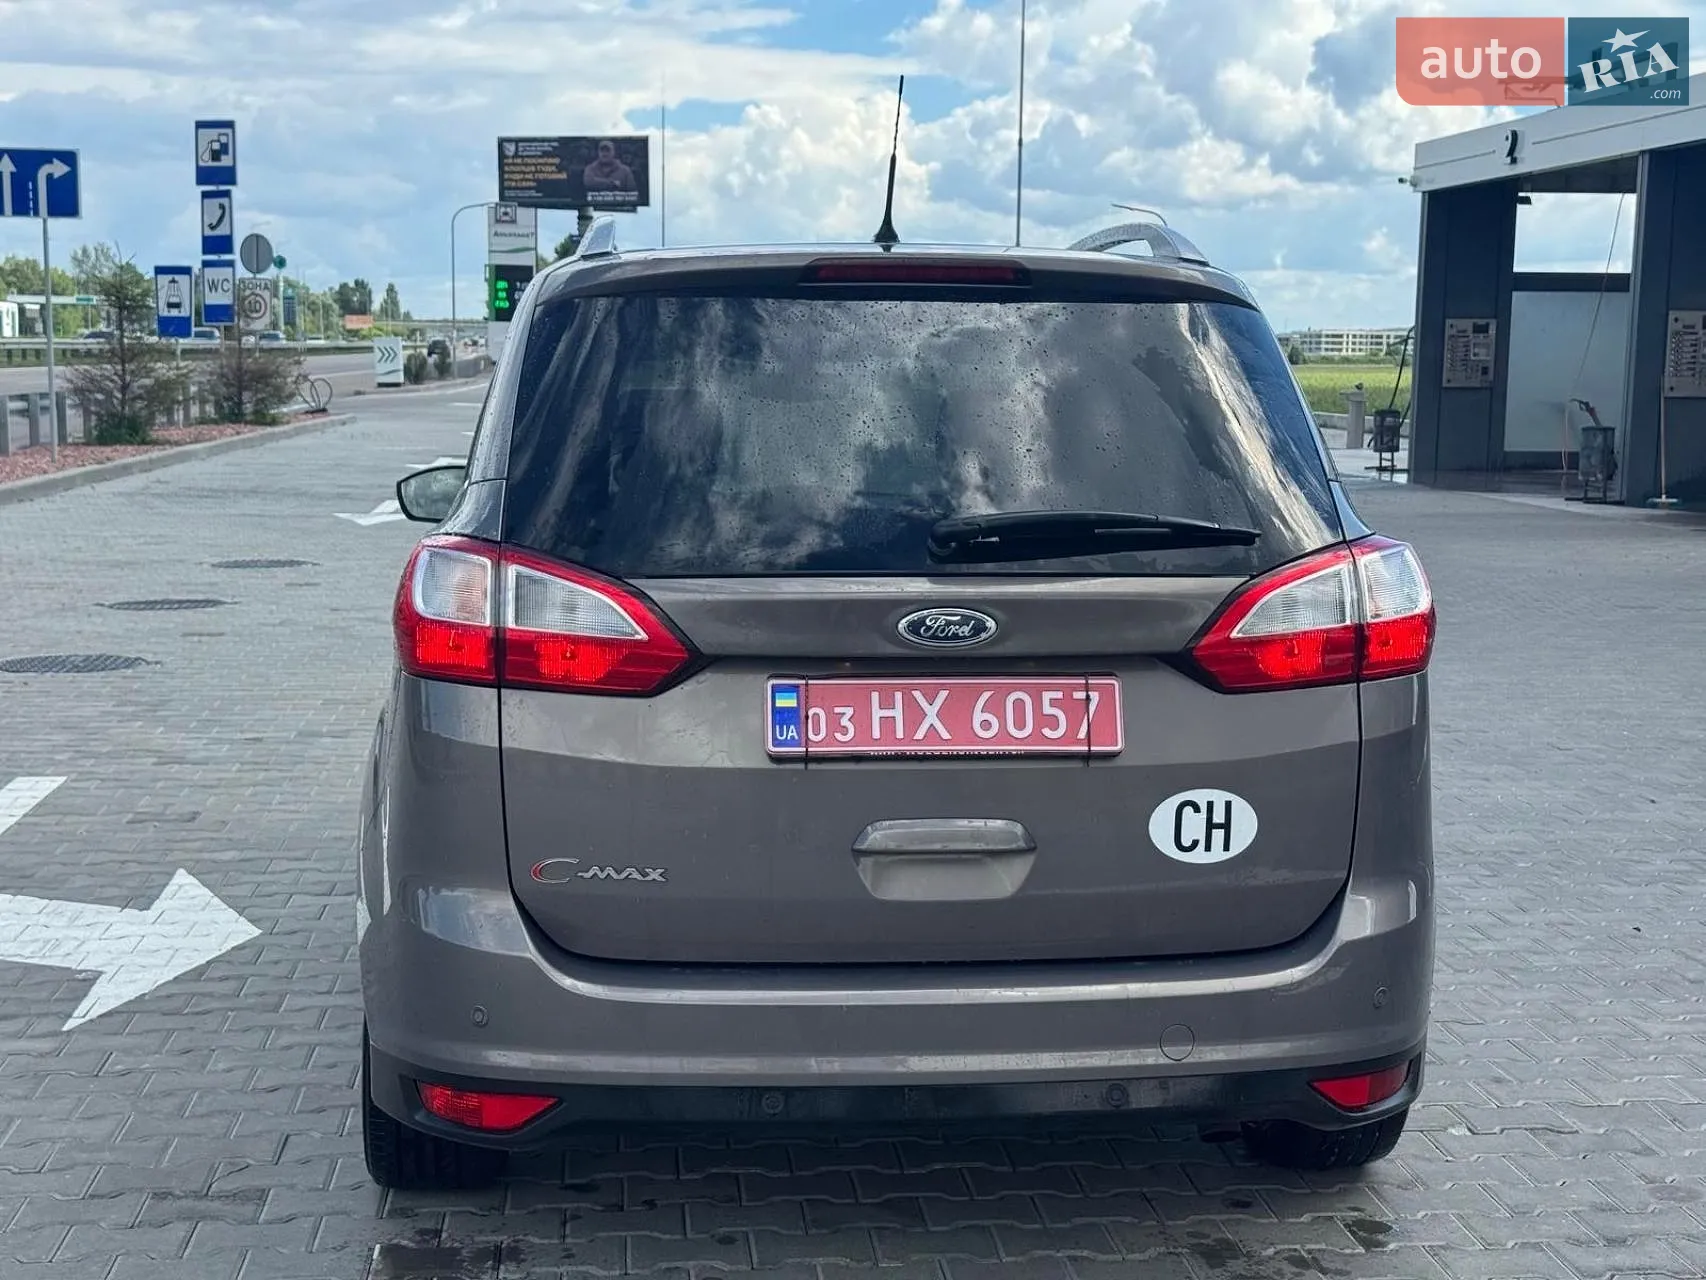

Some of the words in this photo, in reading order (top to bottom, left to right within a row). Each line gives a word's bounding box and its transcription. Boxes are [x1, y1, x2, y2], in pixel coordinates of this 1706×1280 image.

[207, 278, 231, 293] WC
[920, 614, 975, 638] Ford
[776, 724, 799, 740] UA
[971, 689, 1100, 740] 6057
[1173, 799, 1232, 853] CH
